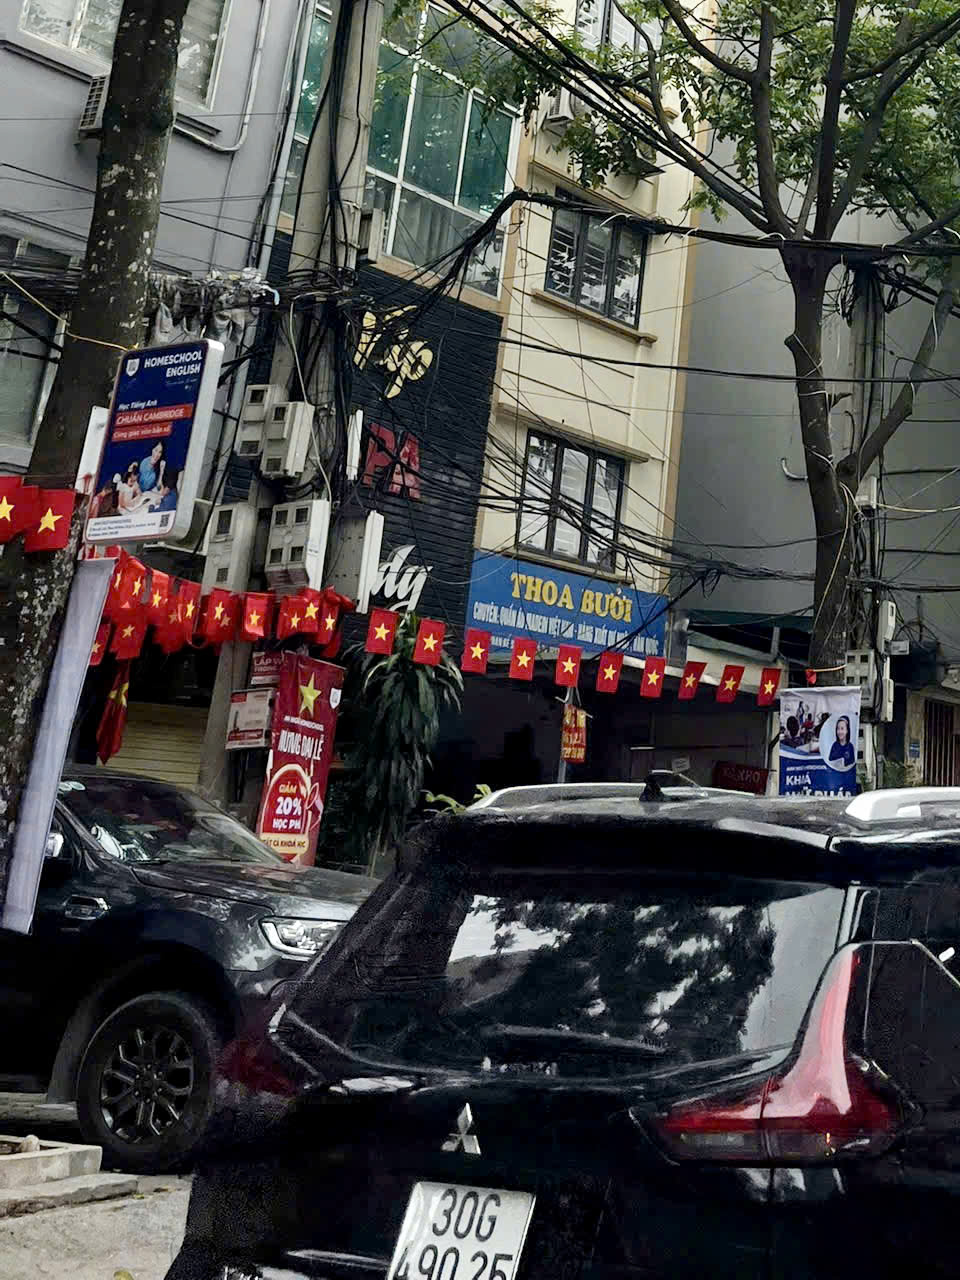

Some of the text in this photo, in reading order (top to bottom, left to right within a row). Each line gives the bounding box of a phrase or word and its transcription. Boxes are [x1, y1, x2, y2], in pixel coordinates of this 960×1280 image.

[144, 350, 203, 368] HOMESCHOOL
[166, 363, 201, 377] ENGLISH
[143, 407, 185, 421] CAMBRIDGE
[511, 572, 633, 624] THOA BƯỞI
[279, 781, 298, 794] GIẢM
[276, 796, 302, 816] 20%
[432, 1188, 501, 1242] 30G
